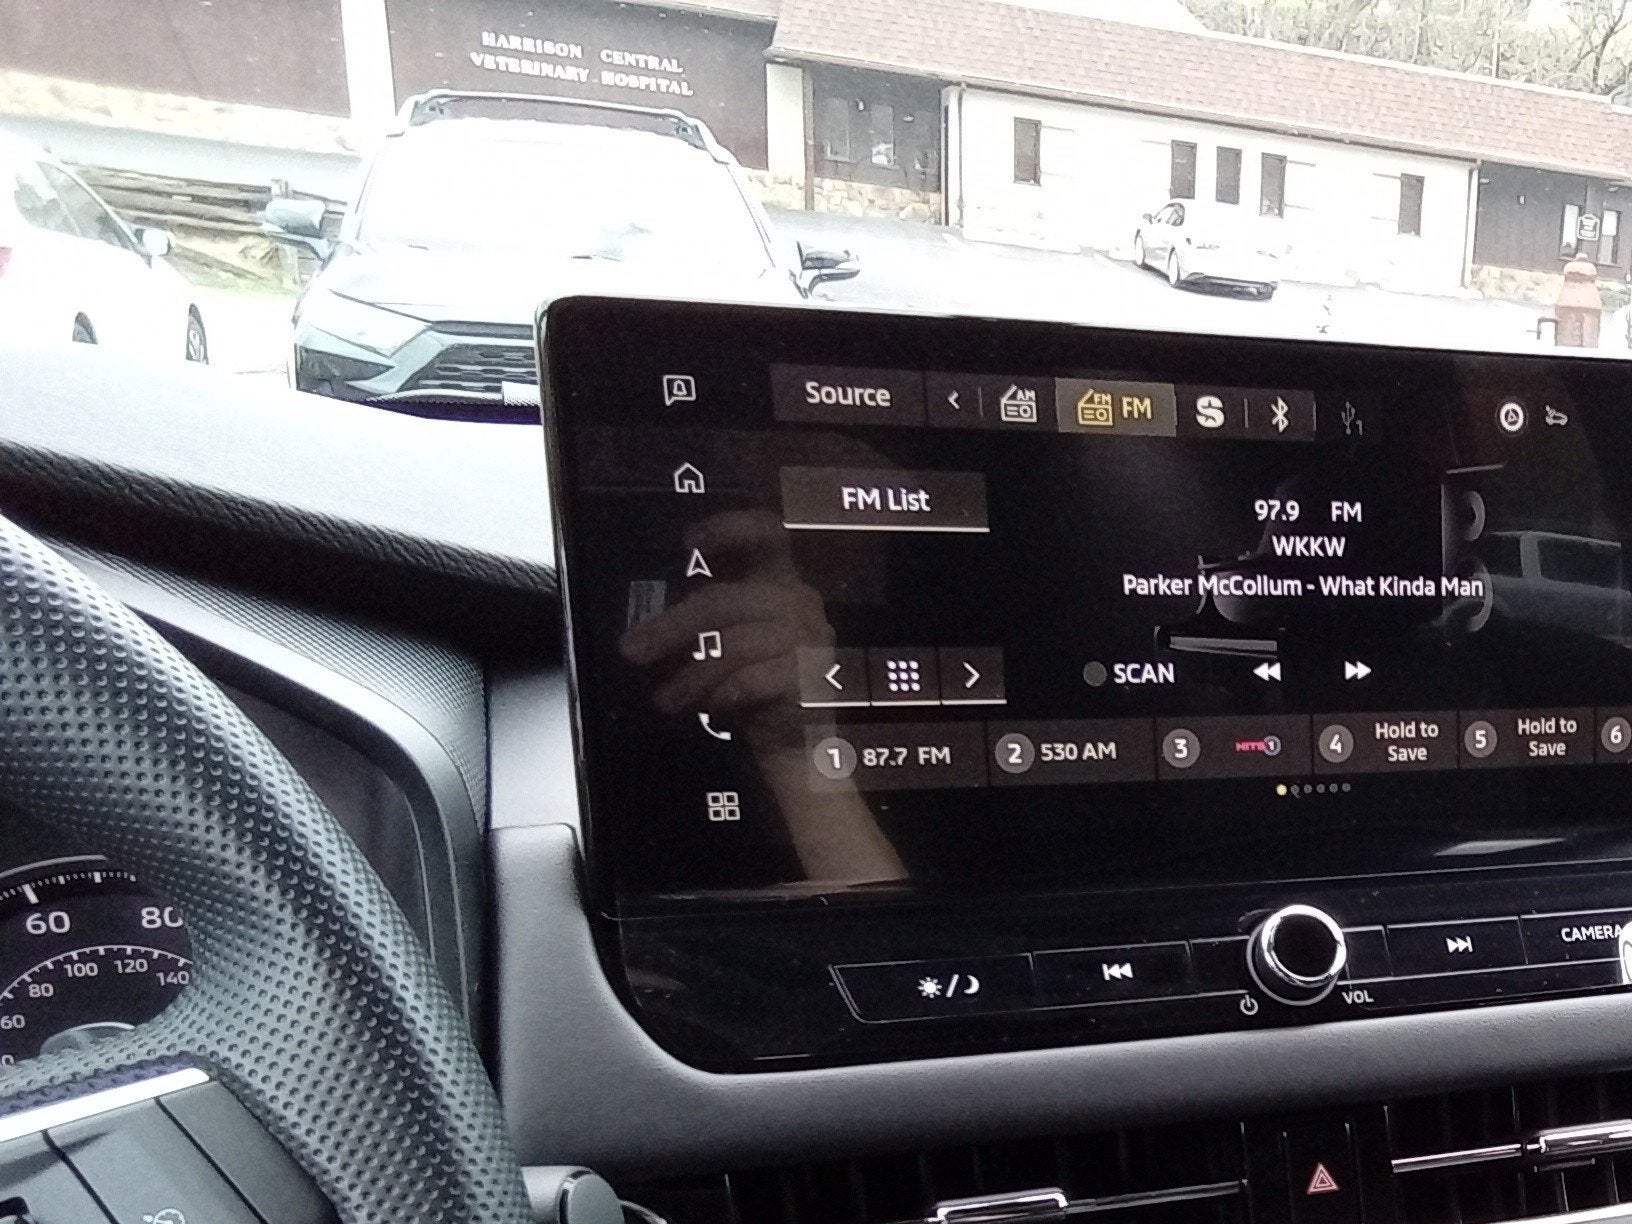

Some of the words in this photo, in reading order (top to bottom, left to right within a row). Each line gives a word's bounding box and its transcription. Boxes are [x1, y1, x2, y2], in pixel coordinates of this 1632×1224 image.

[481, 31, 583, 59] HARRISON
[600, 49, 684, 74] CENTRAL
[470, 52, 590, 83] VETERINARY
[601, 71, 695, 97] HOSPITAL
[805, 381, 891, 407] Source
[1016, 386, 1037, 399] AM
[1093, 393, 1112, 405] FM
[1122, 397, 1152, 420] FM
[841, 486, 881, 511] FM
[888, 487, 931, 512] List
[1254, 499, 1300, 522] 97.9
[1331, 501, 1362, 522] FM
[1272, 535, 1346, 557] WKKW
[1123, 574, 1193, 596] Parker
[1199, 574, 1302, 596] McCollum
[1318, 575, 1375, 597] What
[1379, 575, 1436, 597] Kinda
[1441, 576, 1484, 597] Man
[1113, 663, 1175, 684] SCAN
[1330, 733, 1342, 754] 4
[1375, 721, 1416, 740] Hold
[1419, 722, 1439, 739] to
[1475, 729, 1487, 749] 5
[1518, 717, 1555, 736] Hold
[1558, 718, 1577, 734] to
[1610, 725, 1622, 745] 6
[827, 748, 841, 769] 1
[862, 747, 908, 766] 87.7
[918, 747, 952, 766] FM
[1007, 743, 1022, 763] 2
[1040, 743, 1078, 762] 530
[1081, 742, 1116, 761] AM
[1174, 738, 1188, 758] 3
[1388, 745, 1428, 762] Save
[1529, 741, 1566, 757] Save
[26, 911, 71, 934] 60
[141, 907, 184, 929] 80
[1561, 924, 1622, 942] CAMERA
[63, 962, 99, 978] 100
[114, 959, 149, 974] 120
[156, 971, 190, 986] 140
[29, 983, 54, 998] 80
[1343, 991, 1374, 1005] VOL
[0, 1014, 26, 1030] 60
